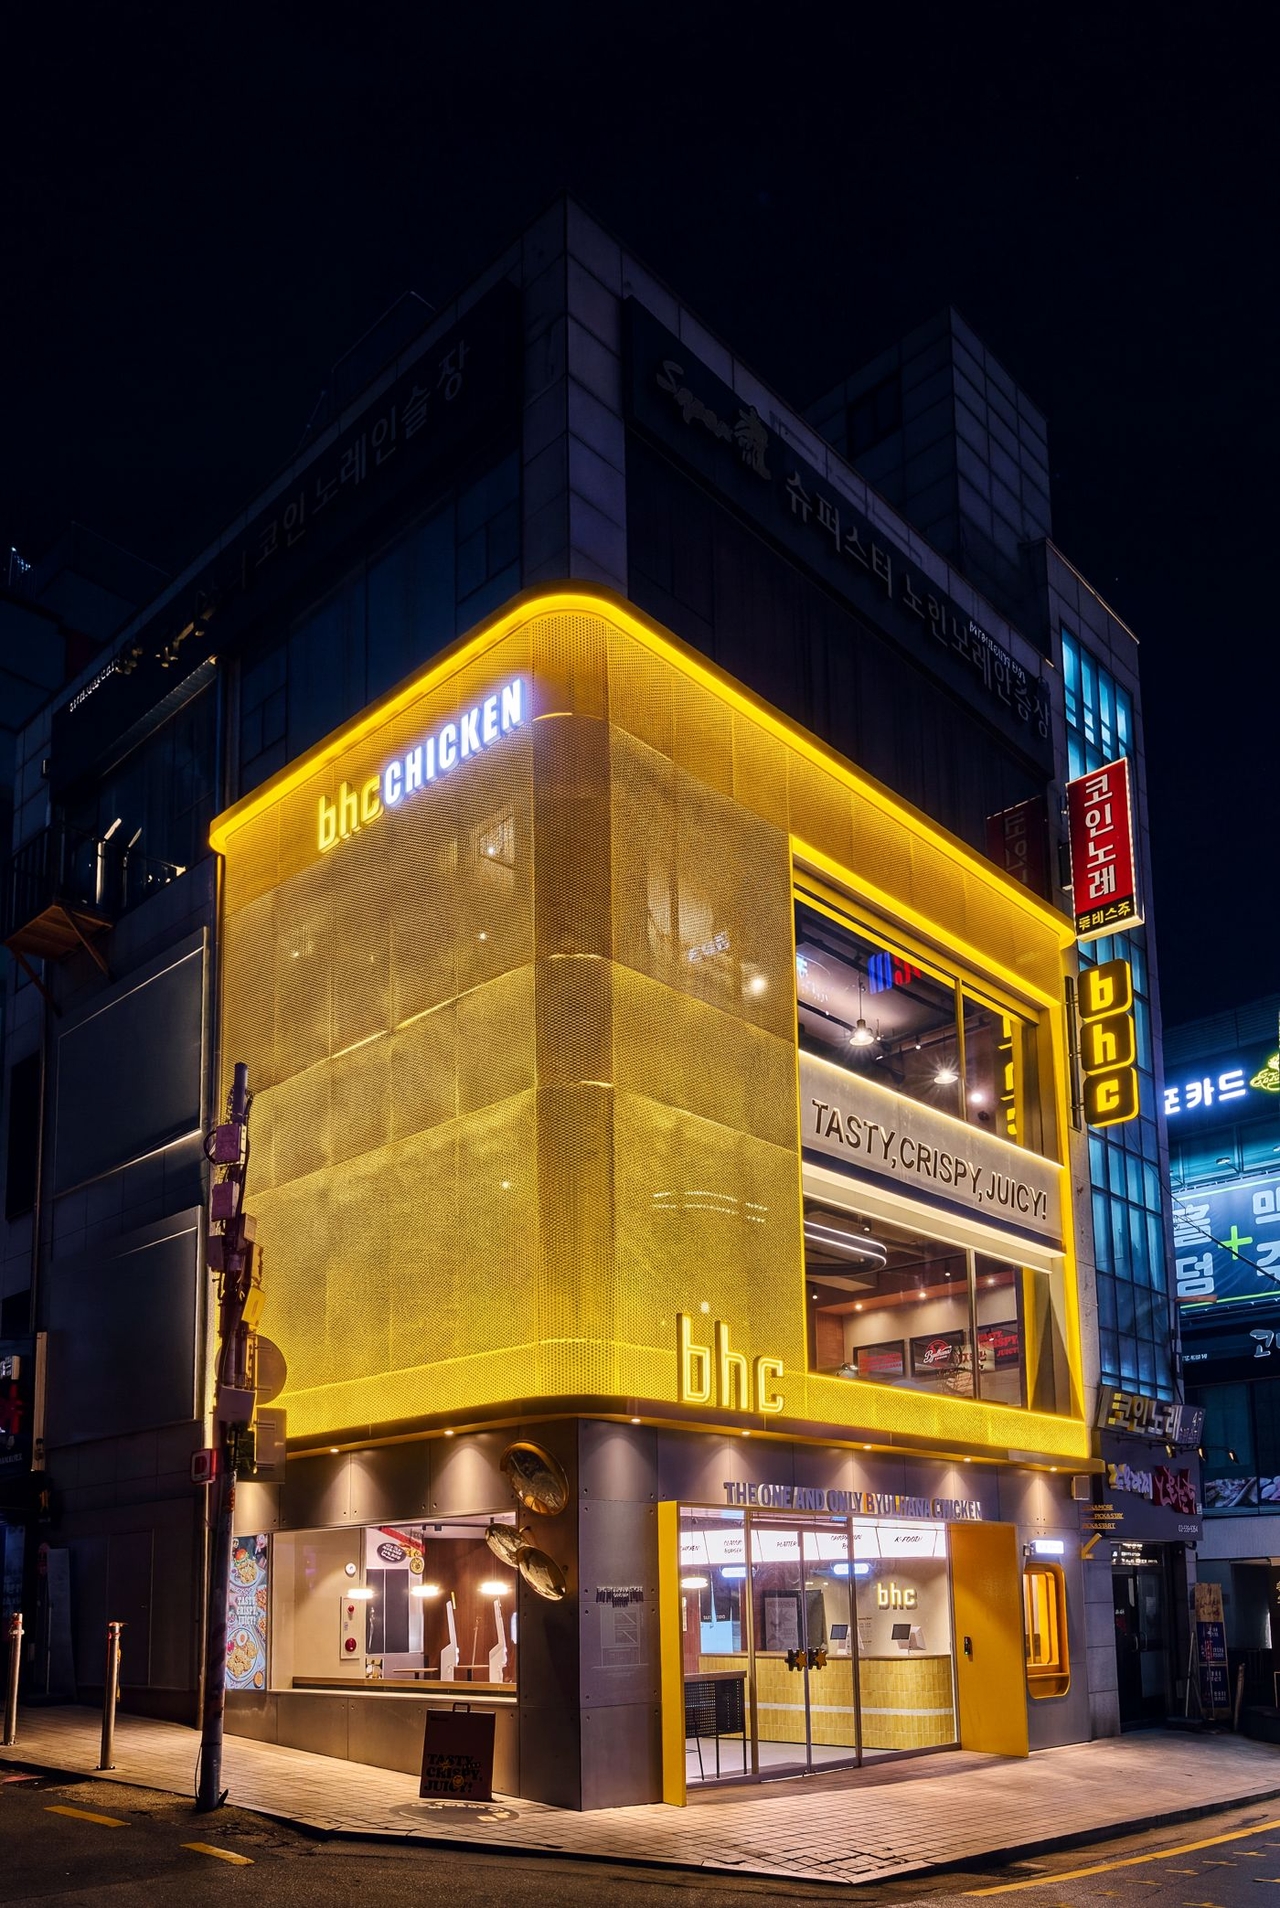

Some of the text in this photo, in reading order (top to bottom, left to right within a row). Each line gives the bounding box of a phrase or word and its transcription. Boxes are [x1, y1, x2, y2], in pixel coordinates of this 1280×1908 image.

[676, 1311, 784, 1414] bhc
[723, 1482, 758, 1504] THE
[758, 1484, 793, 1508] ONE
[793, 1487, 825, 1511] AND
[826, 1490, 862, 1513] ONLY
[931, 1498, 982, 1521] CHICKEN
[877, 1582, 916, 1609] bhc
